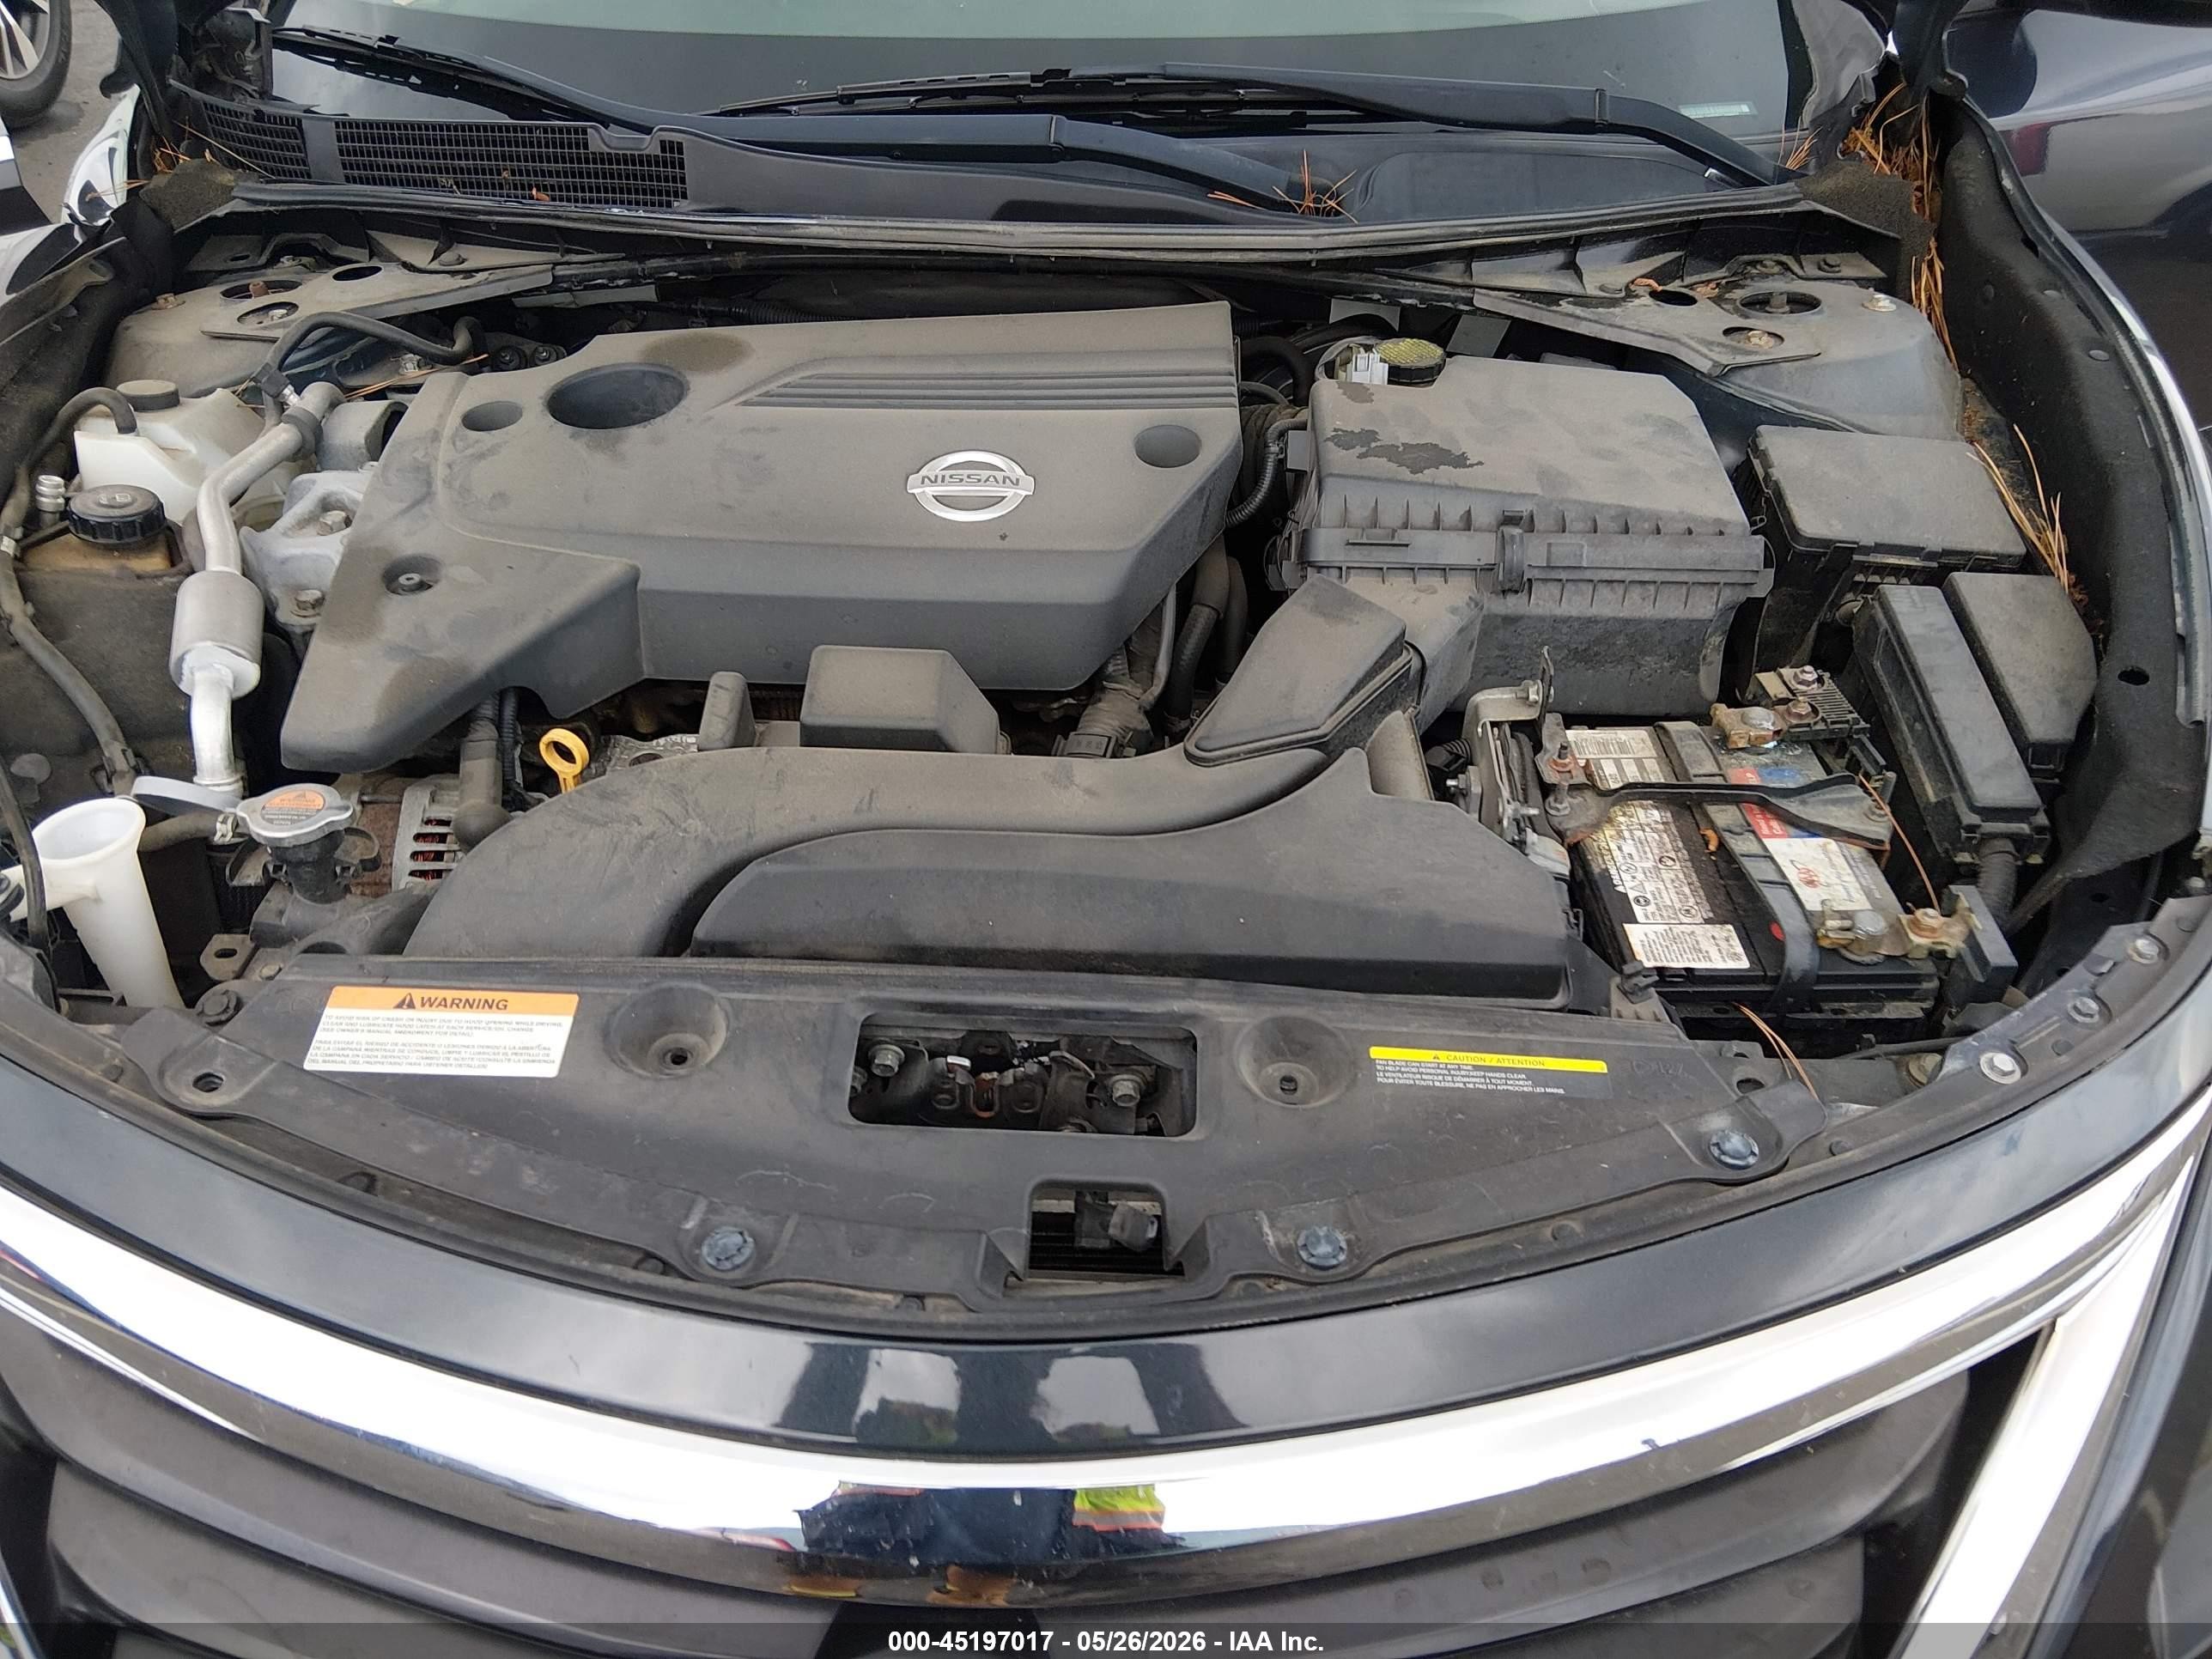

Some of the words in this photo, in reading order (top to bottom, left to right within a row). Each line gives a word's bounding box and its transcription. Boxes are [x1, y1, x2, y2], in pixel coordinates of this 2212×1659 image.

[921, 474, 1019, 486] NISSAN
[421, 996, 509, 1011] WARNING
[1497, 1057, 1545, 1066] ATTENTION
